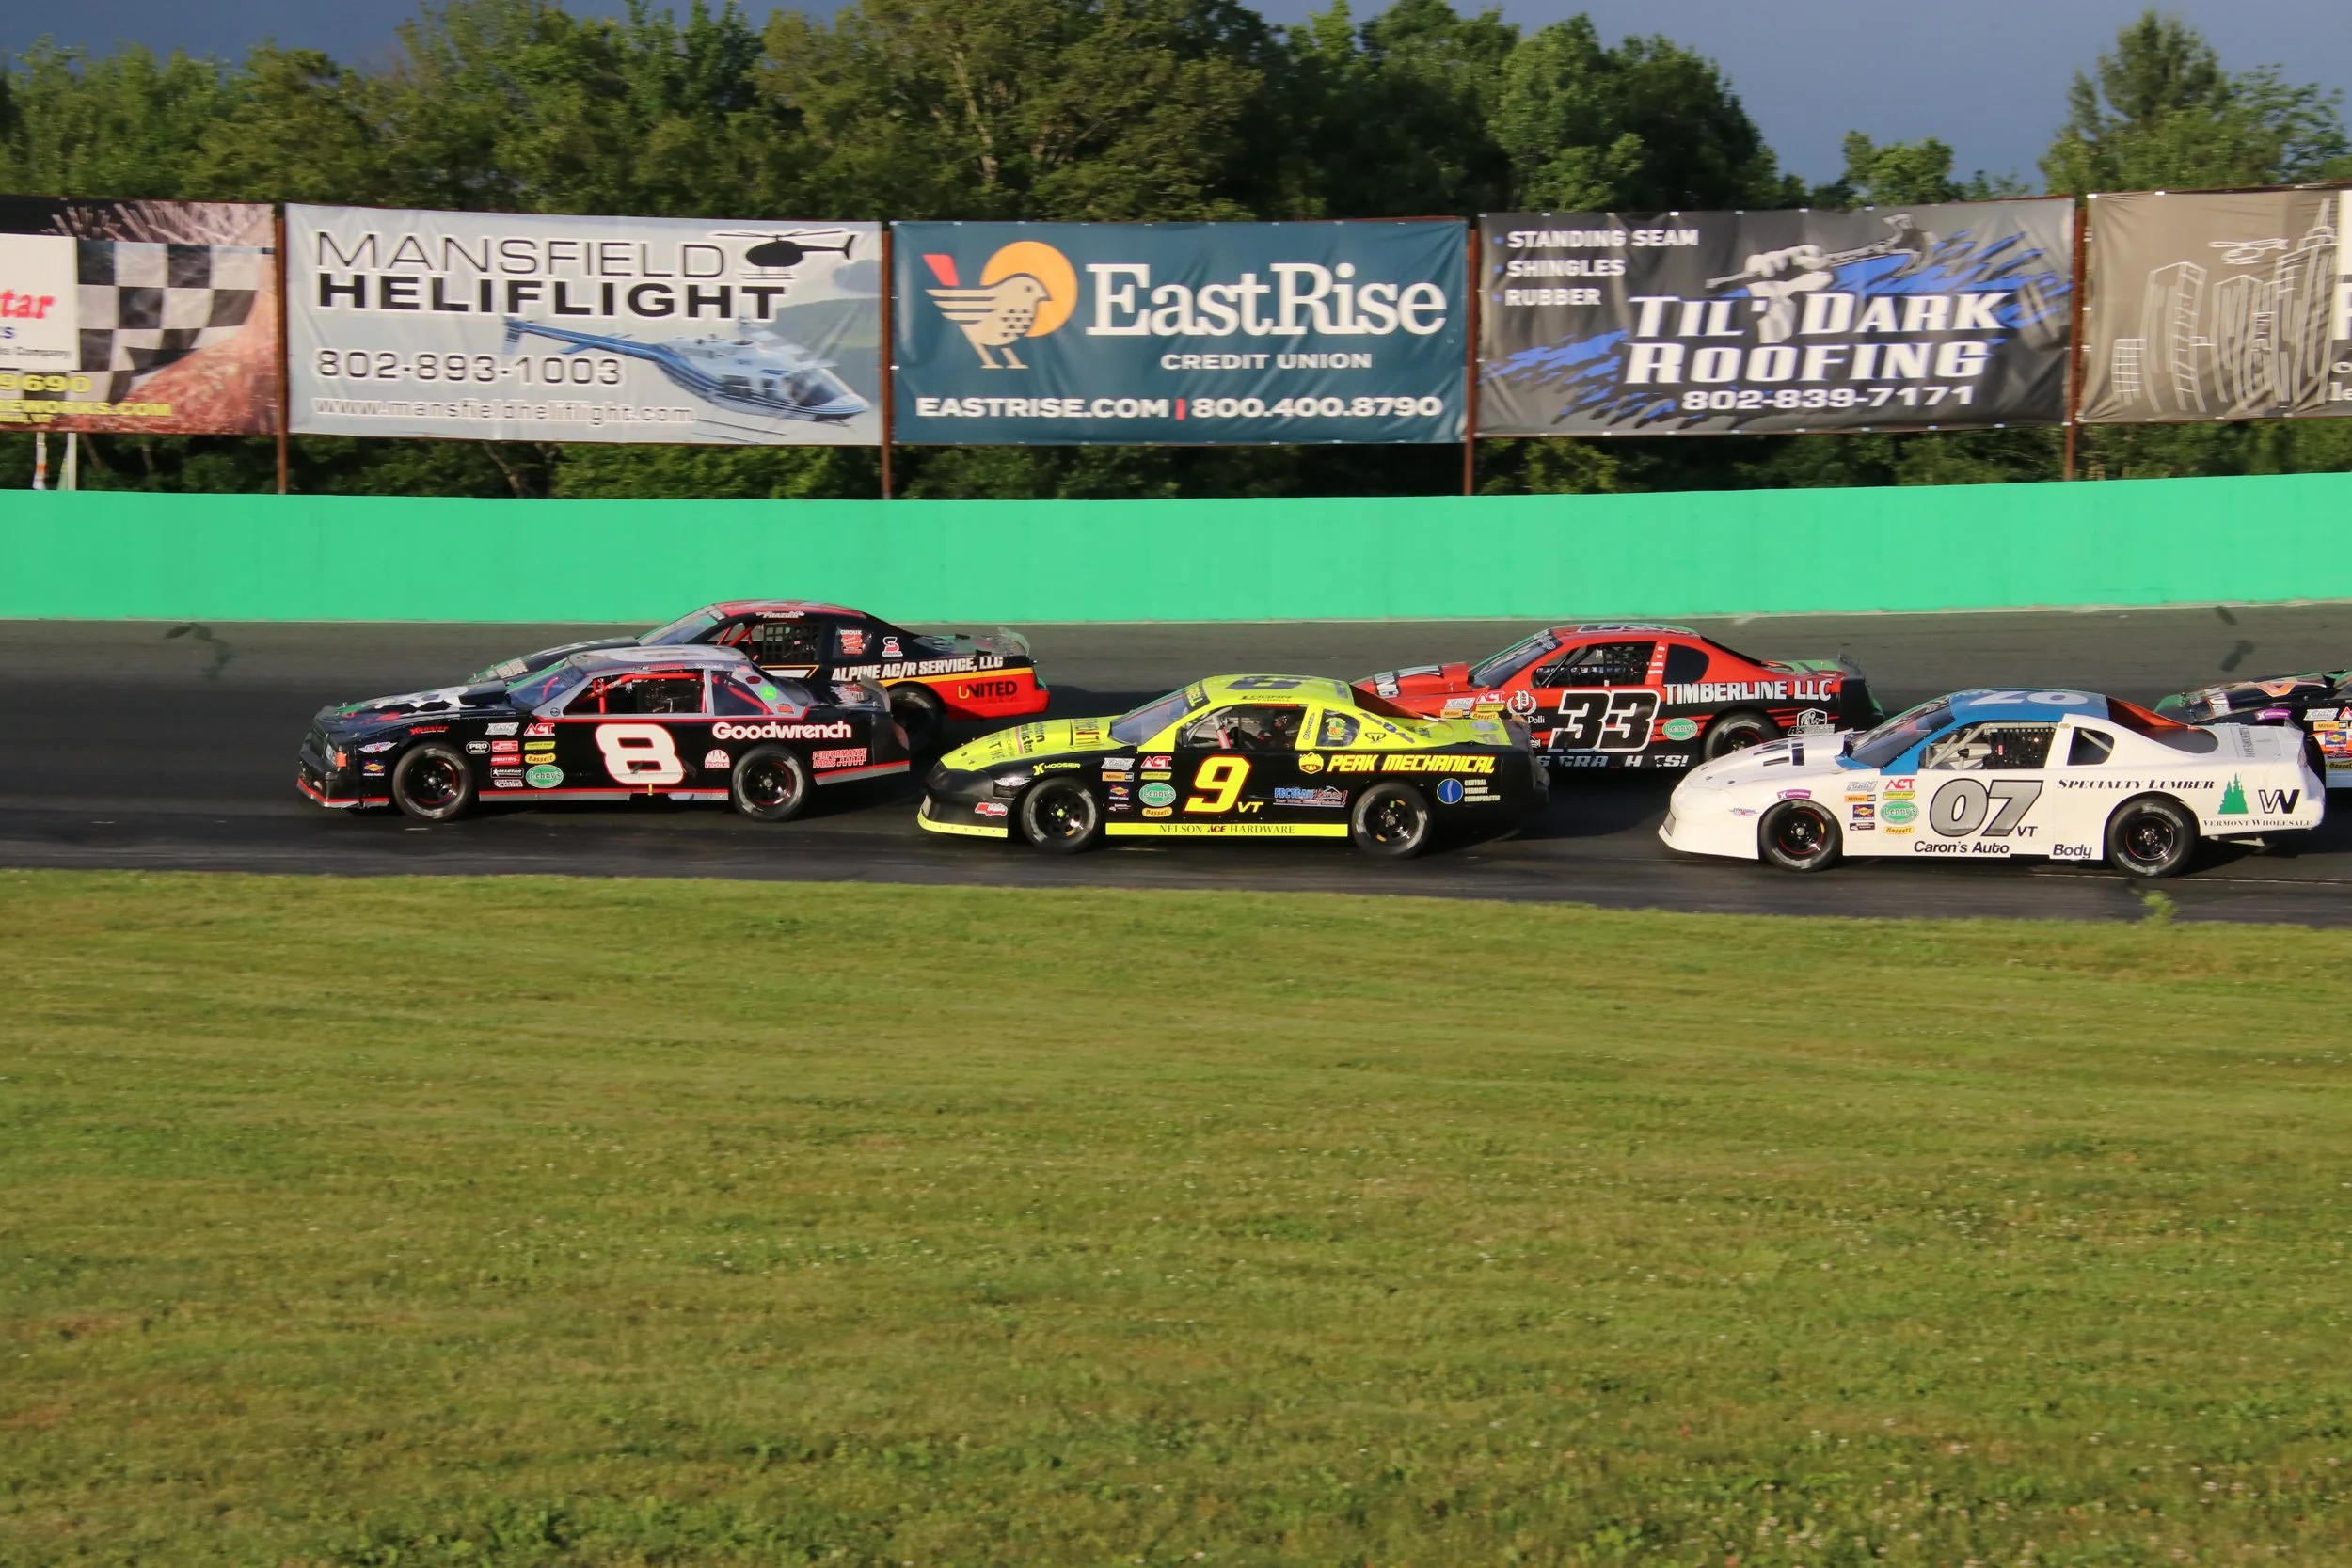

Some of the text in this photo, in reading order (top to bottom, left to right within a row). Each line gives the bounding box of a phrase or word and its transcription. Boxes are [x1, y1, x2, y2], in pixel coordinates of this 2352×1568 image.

[1507, 229, 1699, 248] STANDING SEAM
[316, 230, 724, 278] MANSFIELD
[1507, 259, 1626, 277] SHINGLES
[318, 272, 785, 320] HELIFLIGHT
[1086, 262, 1447, 336] EastRise
[1505, 288, 1601, 306] RUBBER
[1798, 292, 2011, 335] DARK
[318, 349, 621, 386] 802-893-1003
[1160, 353, 1373, 370] CREDIT UNION
[1624, 341, 1994, 385] ROOFING
[915, 396, 1443, 418] EASTRISE.COM 800.400.8790
[1682, 385, 1974, 410] 802-839-7171
[832, 656, 1004, 682] ALPINE AC/R SERVICE, LLC
[958, 680, 1018, 700] UNITED
[1663, 679, 1833, 705] TIMBERLINE LLC
[712, 721, 852, 740] Goodwrench
[1547, 689, 1661, 752] 33
[596, 722, 687, 785] 8
[813, 748, 867, 760] PERFORMANCE
[1326, 753, 1496, 774] PEAK MECHANICAL
[1183, 754, 1252, 814] 9
[1885, 778, 1915, 790] ACT
[2148, 779, 2216, 789] LUMBER
[1237, 802, 1264, 813] VT
[1930, 777, 2044, 838] 07
[2258, 788, 2301, 815] W
[1159, 824, 1295, 834] NELSON ACE HARDWARE
[2017, 826, 2038, 837] VT
[2252, 818, 2313, 827] WHOLESALE
[1914, 840, 2010, 853] Caron's Auto
[2053, 844, 2093, 859] Body
